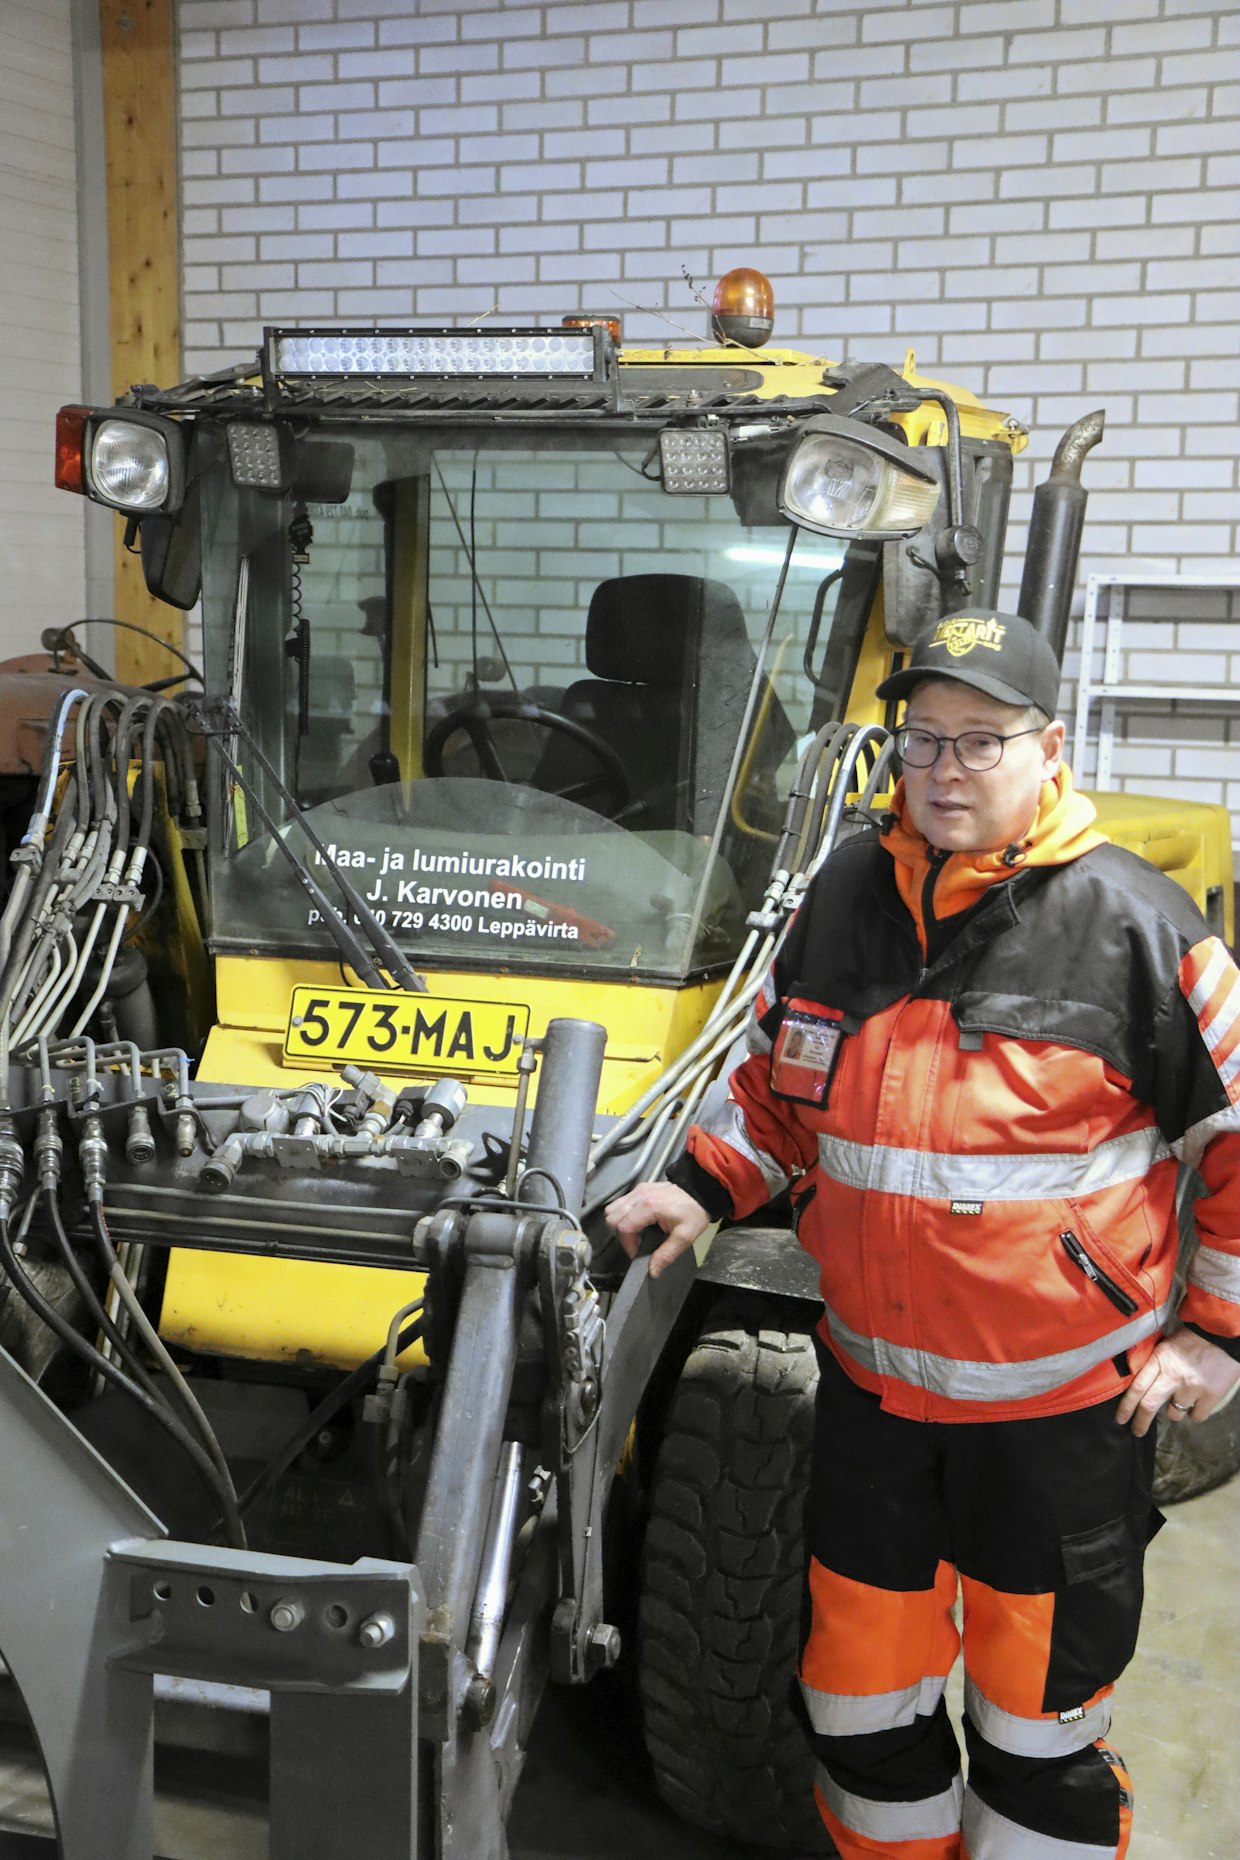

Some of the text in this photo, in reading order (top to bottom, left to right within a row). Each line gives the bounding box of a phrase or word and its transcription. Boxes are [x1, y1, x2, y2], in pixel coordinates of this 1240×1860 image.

[315, 844, 587, 881] Maa- ja lumiurakointi
[366, 879, 522, 909] J. Karvonen
[392, 911, 424, 928] 729
[428, 913, 472, 931] 4300
[478, 916, 578, 939] Leppävirta
[299, 999, 515, 1062] 573-MAJ
